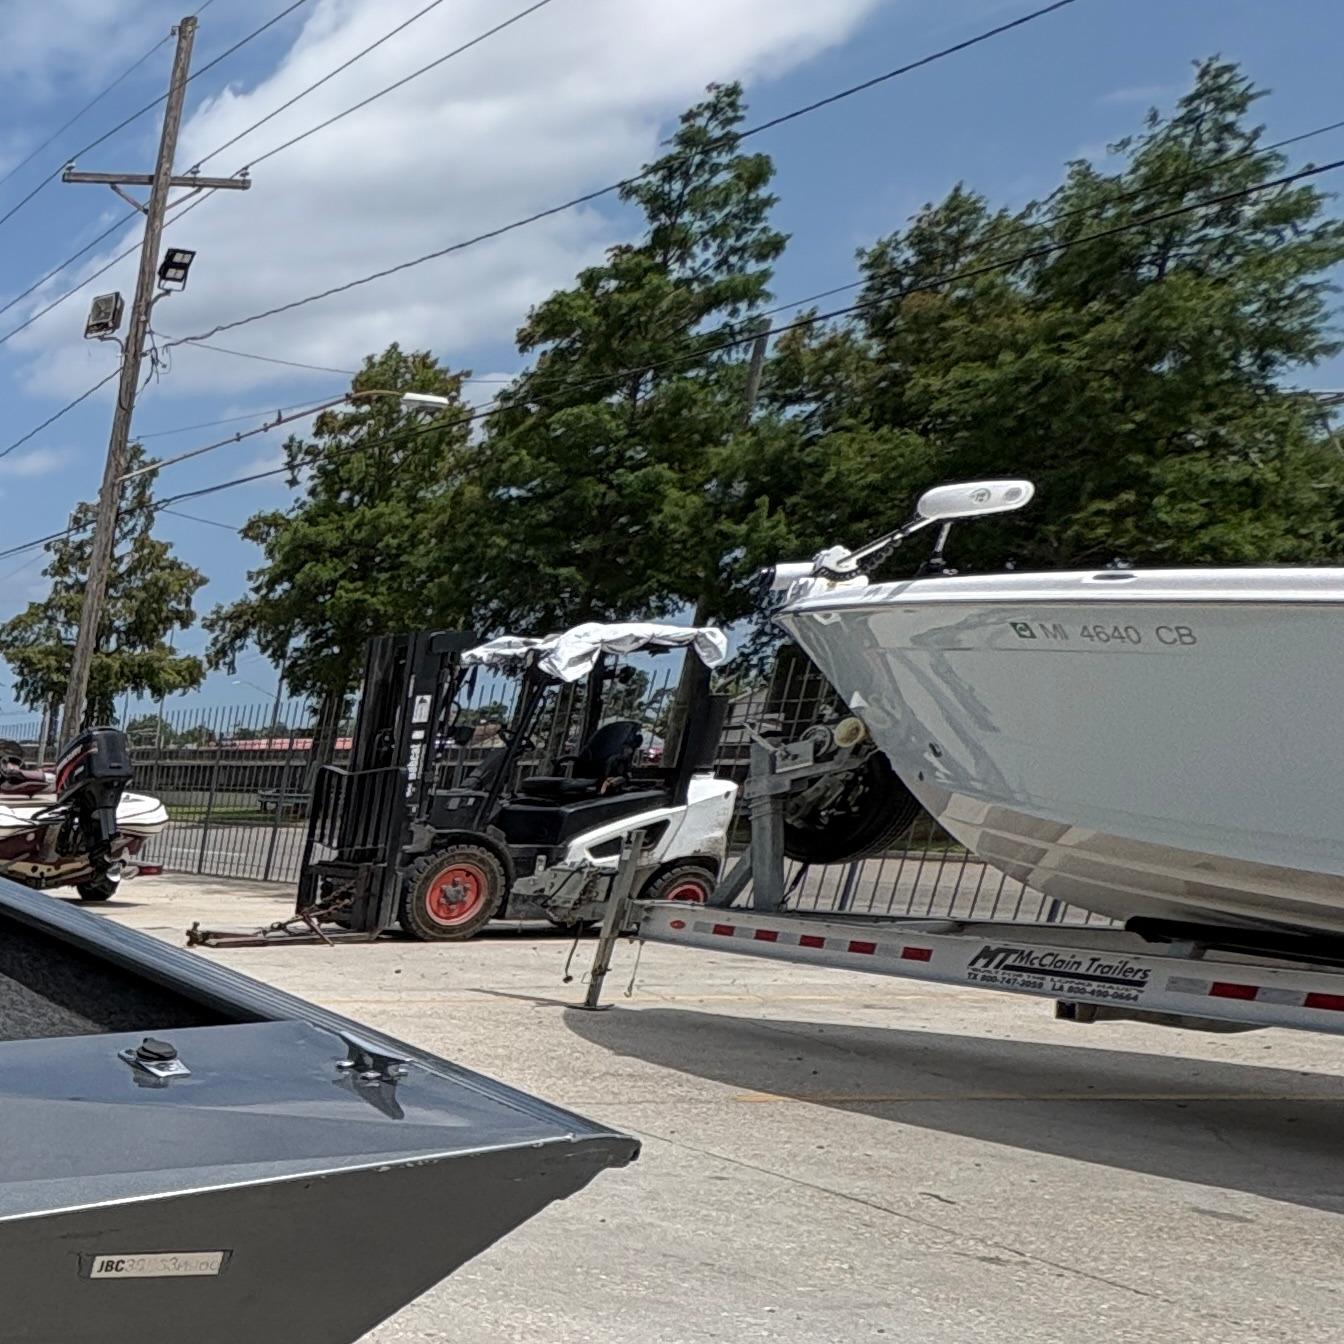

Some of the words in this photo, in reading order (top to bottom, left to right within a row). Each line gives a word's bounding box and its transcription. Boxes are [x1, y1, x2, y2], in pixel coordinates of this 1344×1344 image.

[1079, 625, 1142, 645] 4640
[1155, 625, 1198, 646] CB
[1012, 949, 1082, 971] McClain
[1086, 957, 1153, 980] Trailers
[1051, 983, 1064, 992] LA
